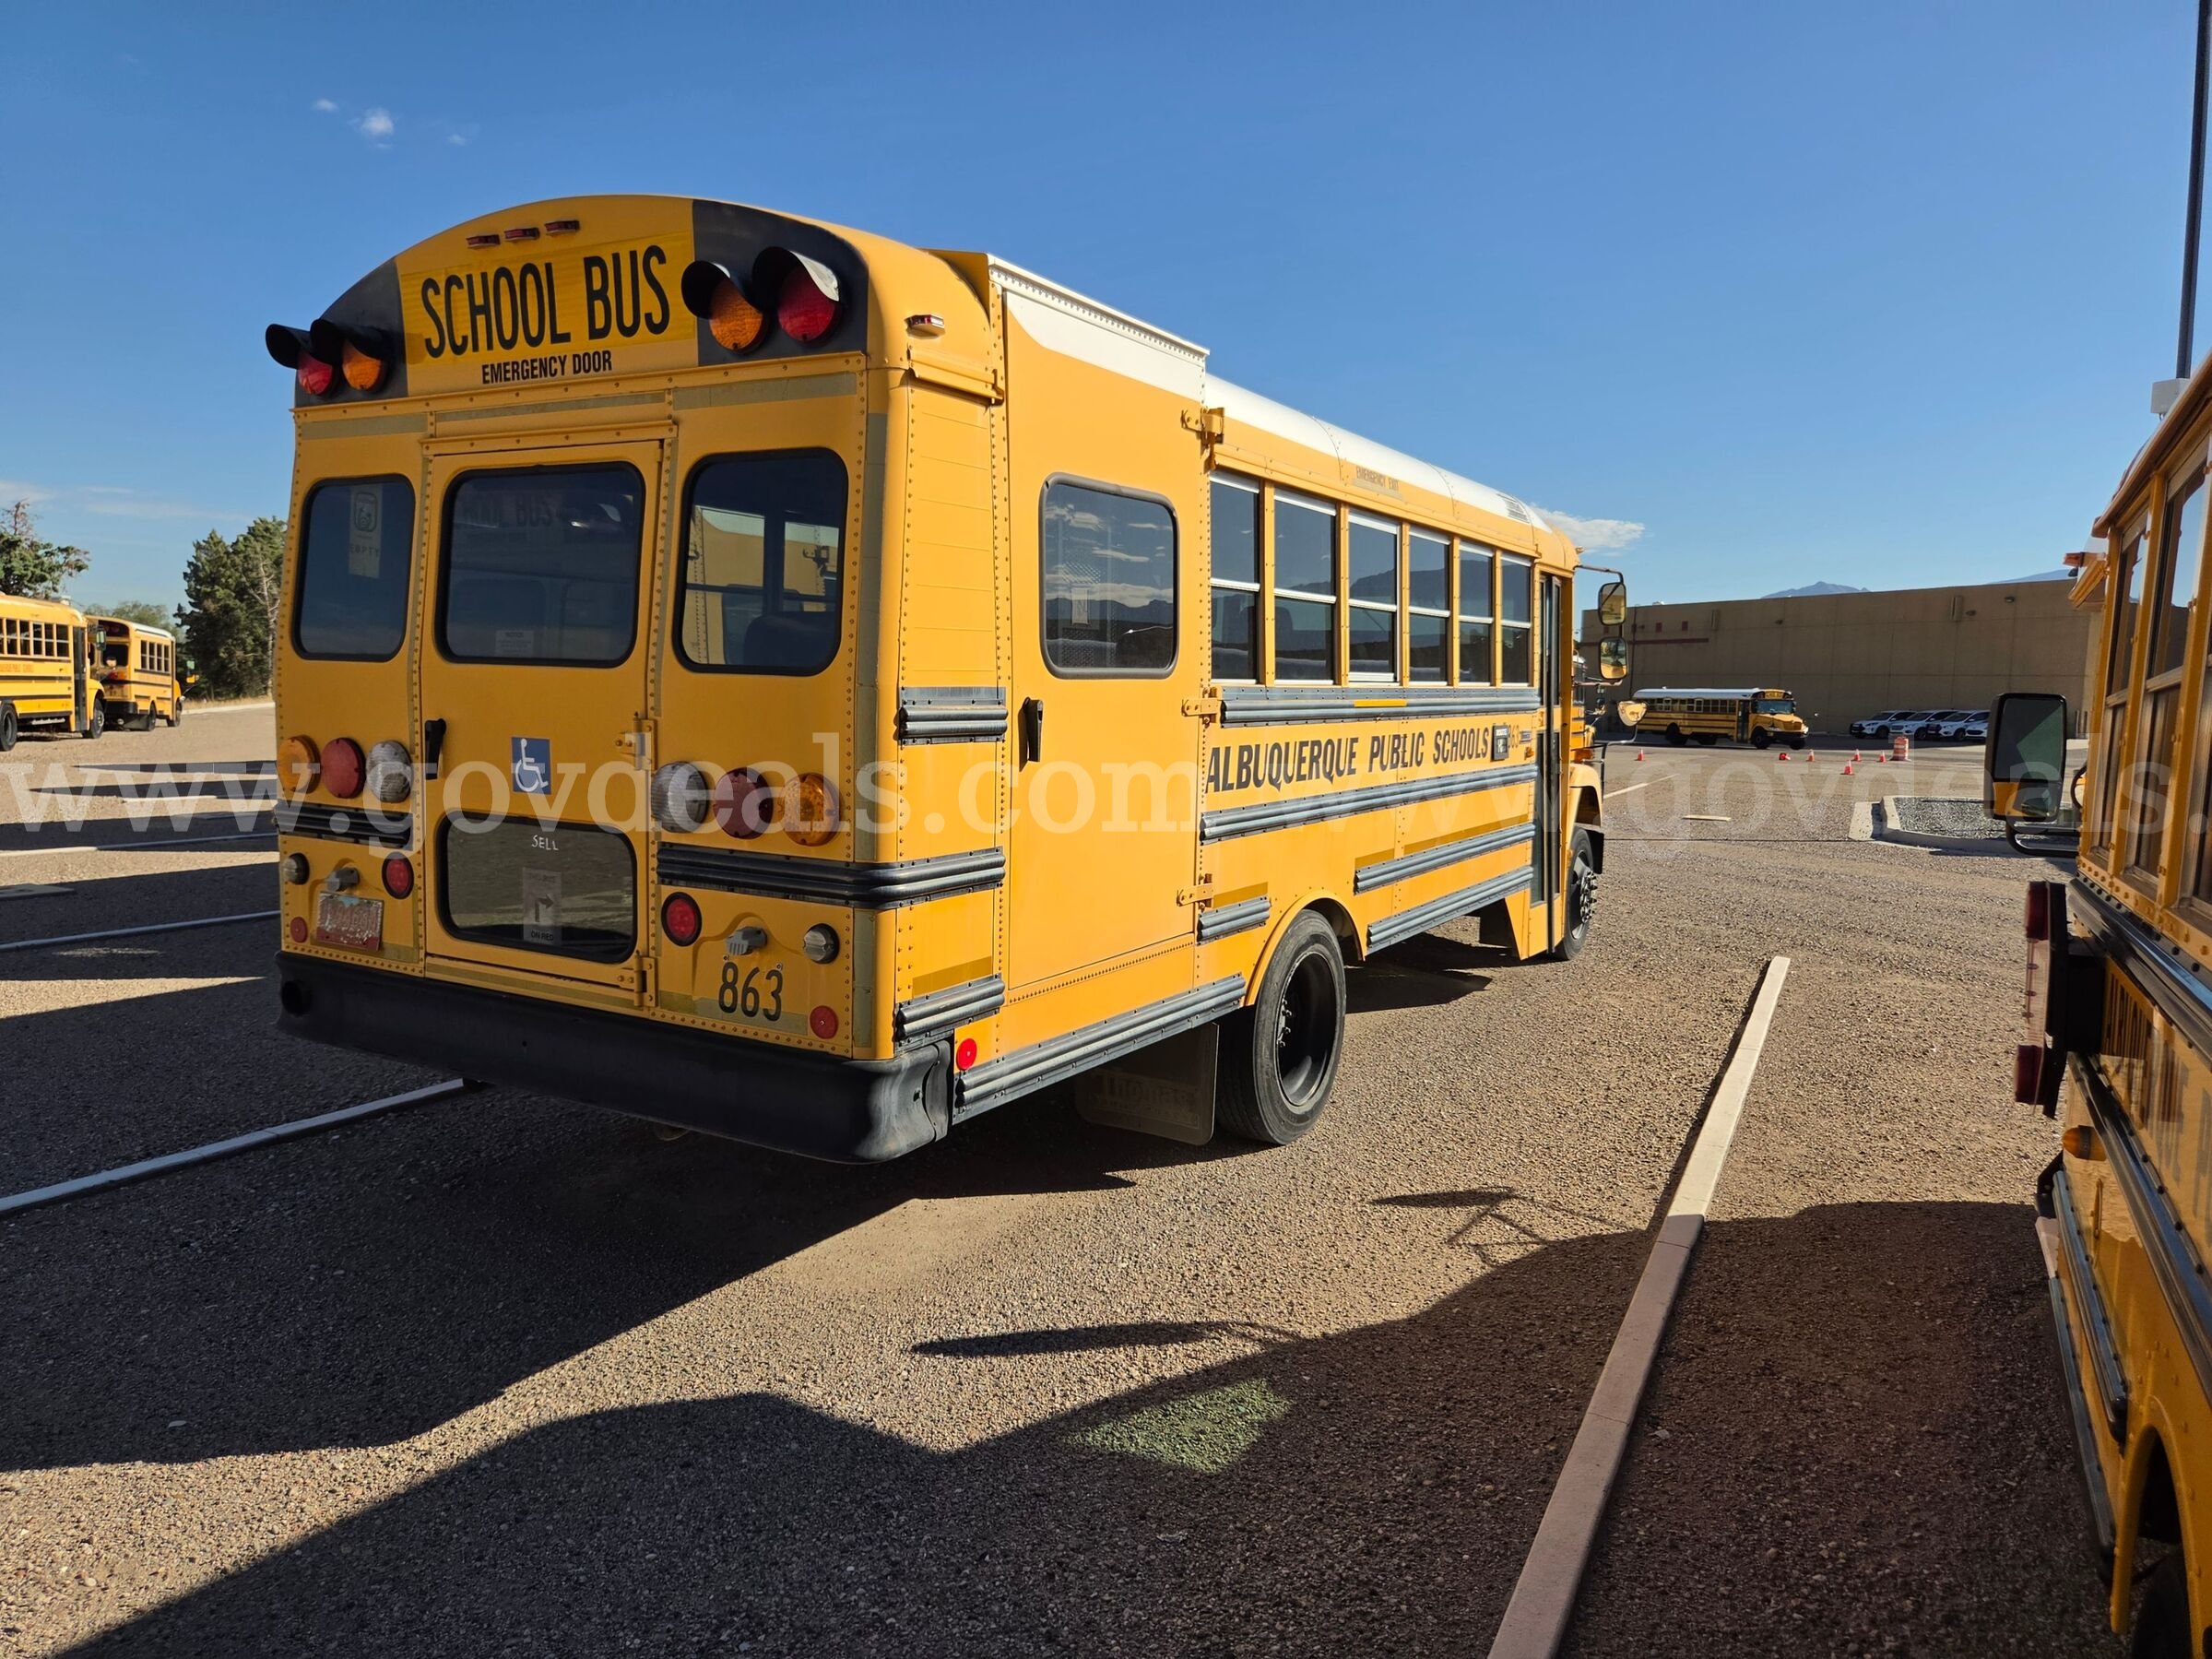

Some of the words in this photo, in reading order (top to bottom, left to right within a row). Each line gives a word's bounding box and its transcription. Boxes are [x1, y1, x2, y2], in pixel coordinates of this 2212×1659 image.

[420, 262, 571, 359] SCHOOL
[583, 244, 670, 340] BUS
[481, 354, 568, 385] EMERGENCY
[573, 350, 612, 374] DOOR
[1356, 465, 1386, 488] EMERGENCY
[1204, 737, 1359, 793] ALBUQUERQUE
[1367, 735, 1425, 774] PUBLIC
[1432, 726, 1489, 764] SCHOOLS
[531, 834, 560, 851] SELL
[718, 961, 784, 1022] 863
